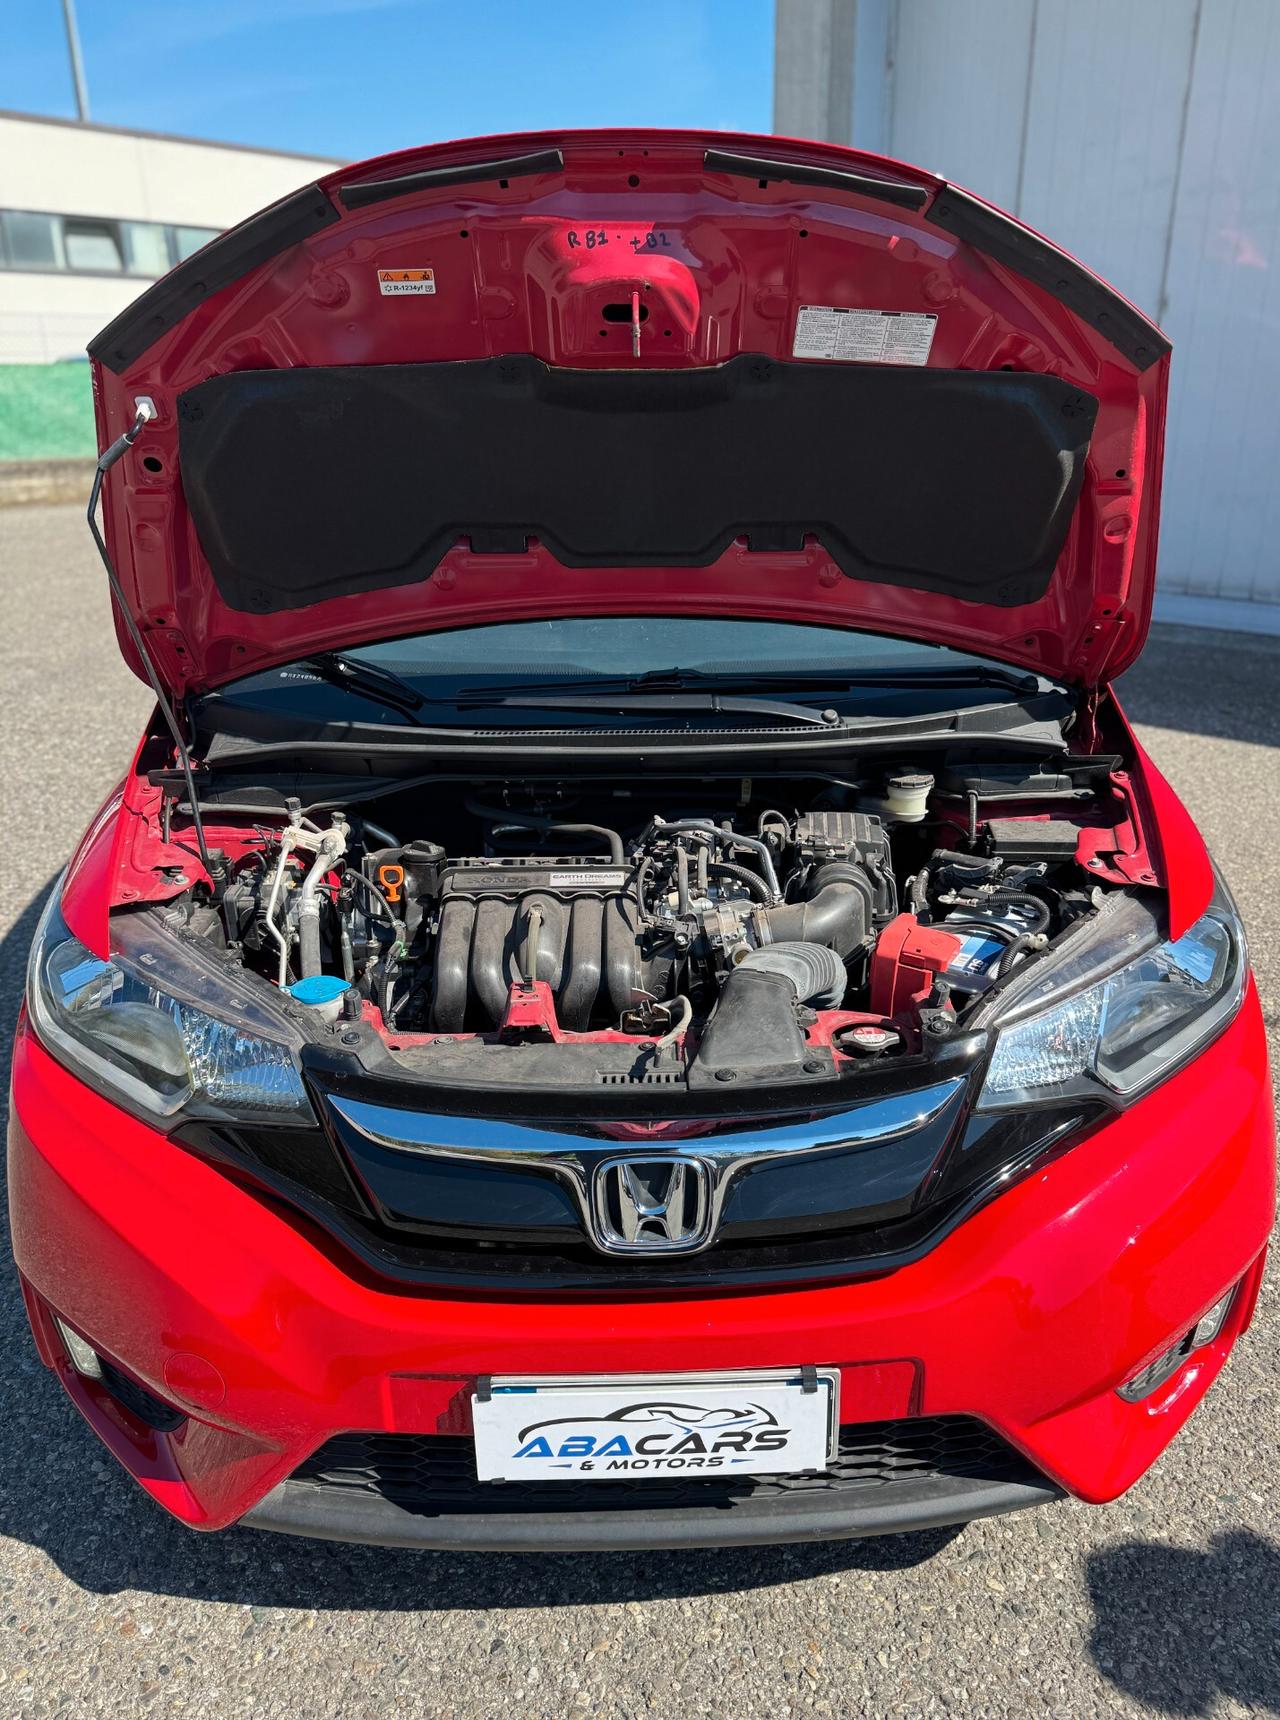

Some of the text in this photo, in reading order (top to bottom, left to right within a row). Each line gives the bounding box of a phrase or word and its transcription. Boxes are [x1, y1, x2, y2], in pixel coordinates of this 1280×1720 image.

[393, 284, 423, 292] R-1234yf
[512, 1429, 792, 1458] ABACARS
[580, 1455, 725, 1471] & MOTORS
